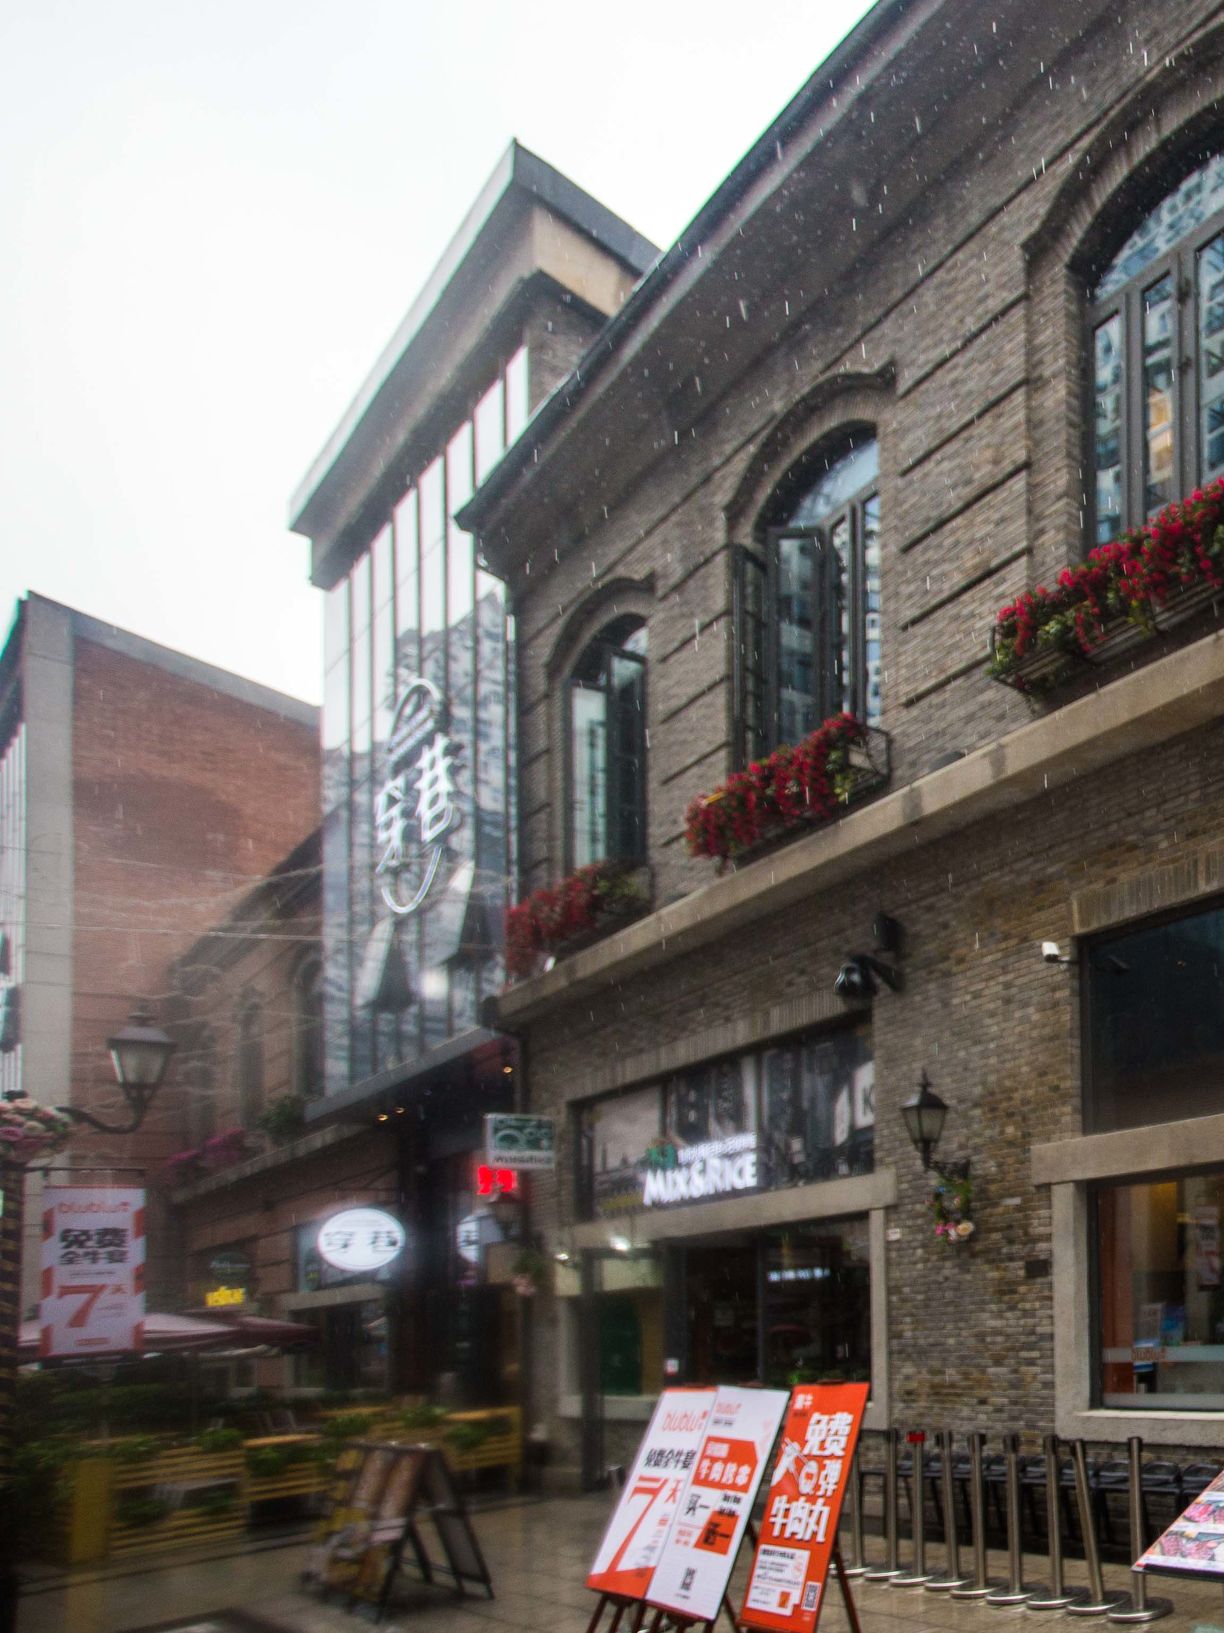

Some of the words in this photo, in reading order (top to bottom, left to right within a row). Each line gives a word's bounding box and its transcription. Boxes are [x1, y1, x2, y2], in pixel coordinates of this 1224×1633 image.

[60, 1228, 129, 1249] 免费
[58, 1284, 108, 1328] 7
[802, 1411, 854, 1457] 免费
[768, 1494, 831, 1543] 牛肉丸
